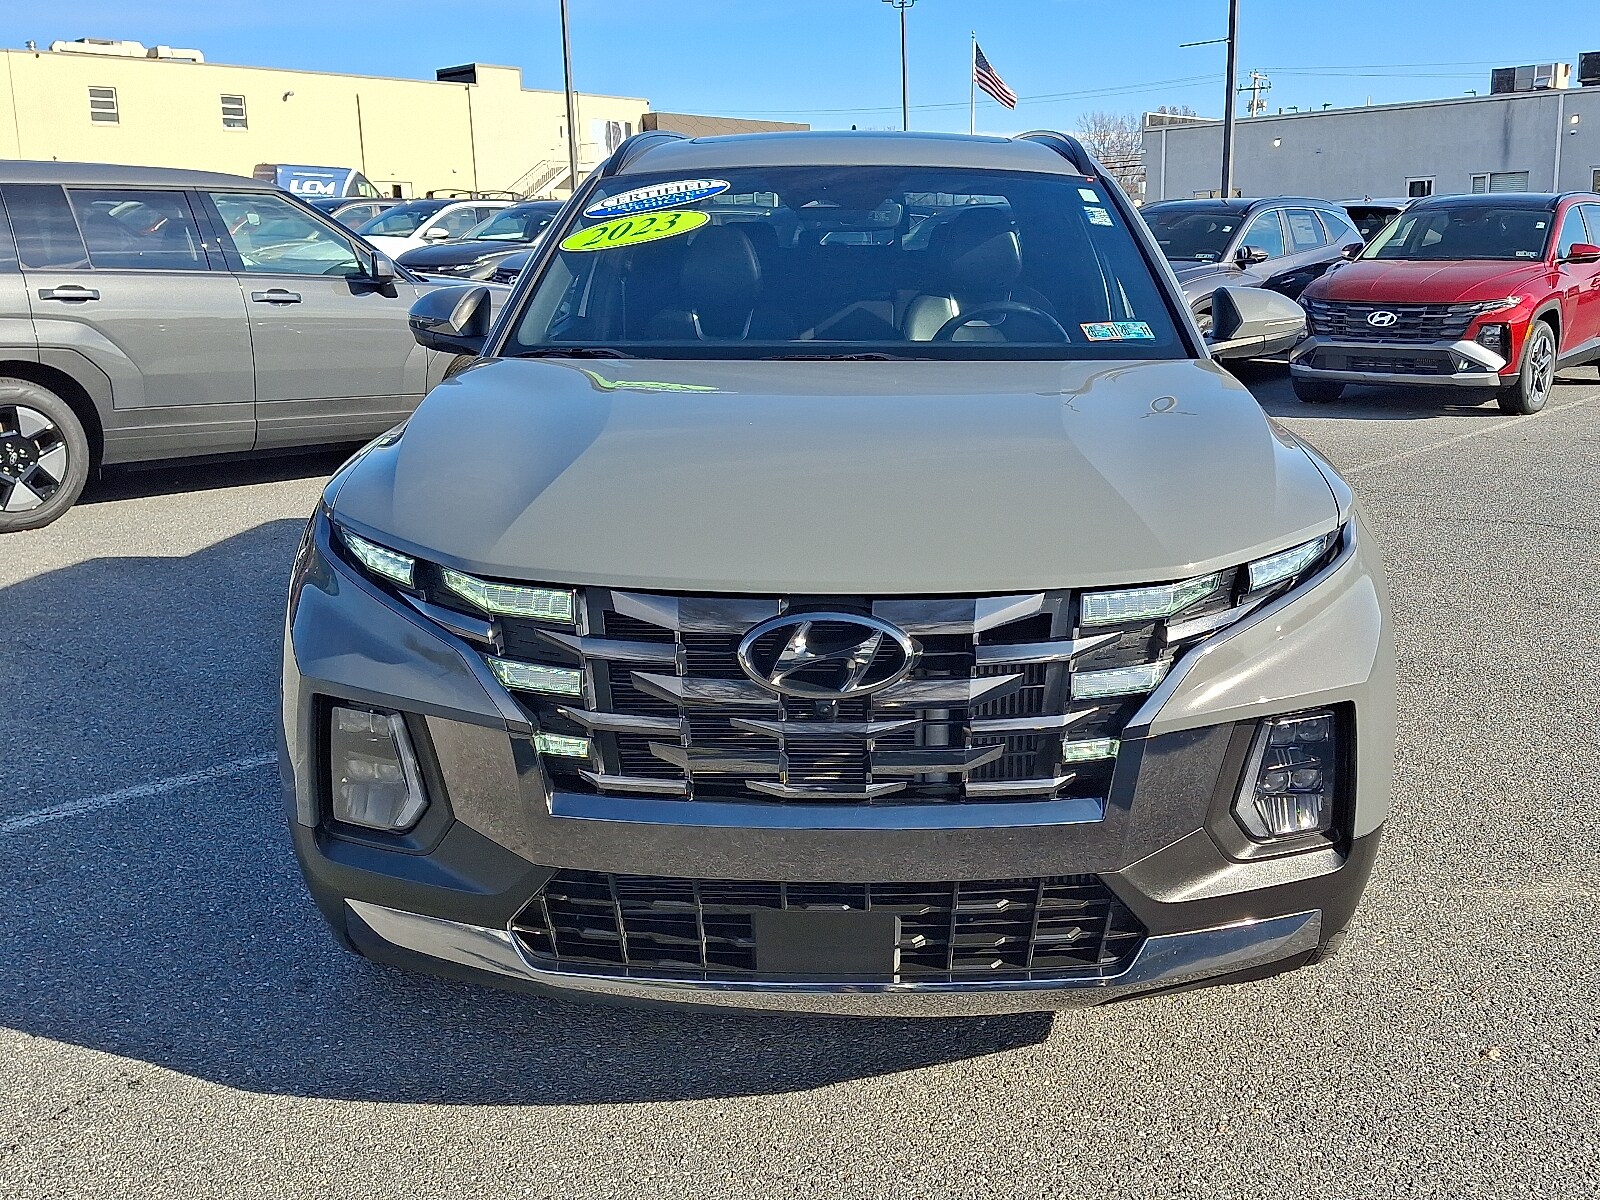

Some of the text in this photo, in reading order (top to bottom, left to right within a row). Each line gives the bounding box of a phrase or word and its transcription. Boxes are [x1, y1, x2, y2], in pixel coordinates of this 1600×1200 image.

[289, 180, 336, 195] LCM
[601, 181, 712, 207] CERTIFIED
[606, 188, 709, 212] PRE-OWNED
[622, 194, 695, 213] VEHICLE
[581, 213, 682, 247] 2023
